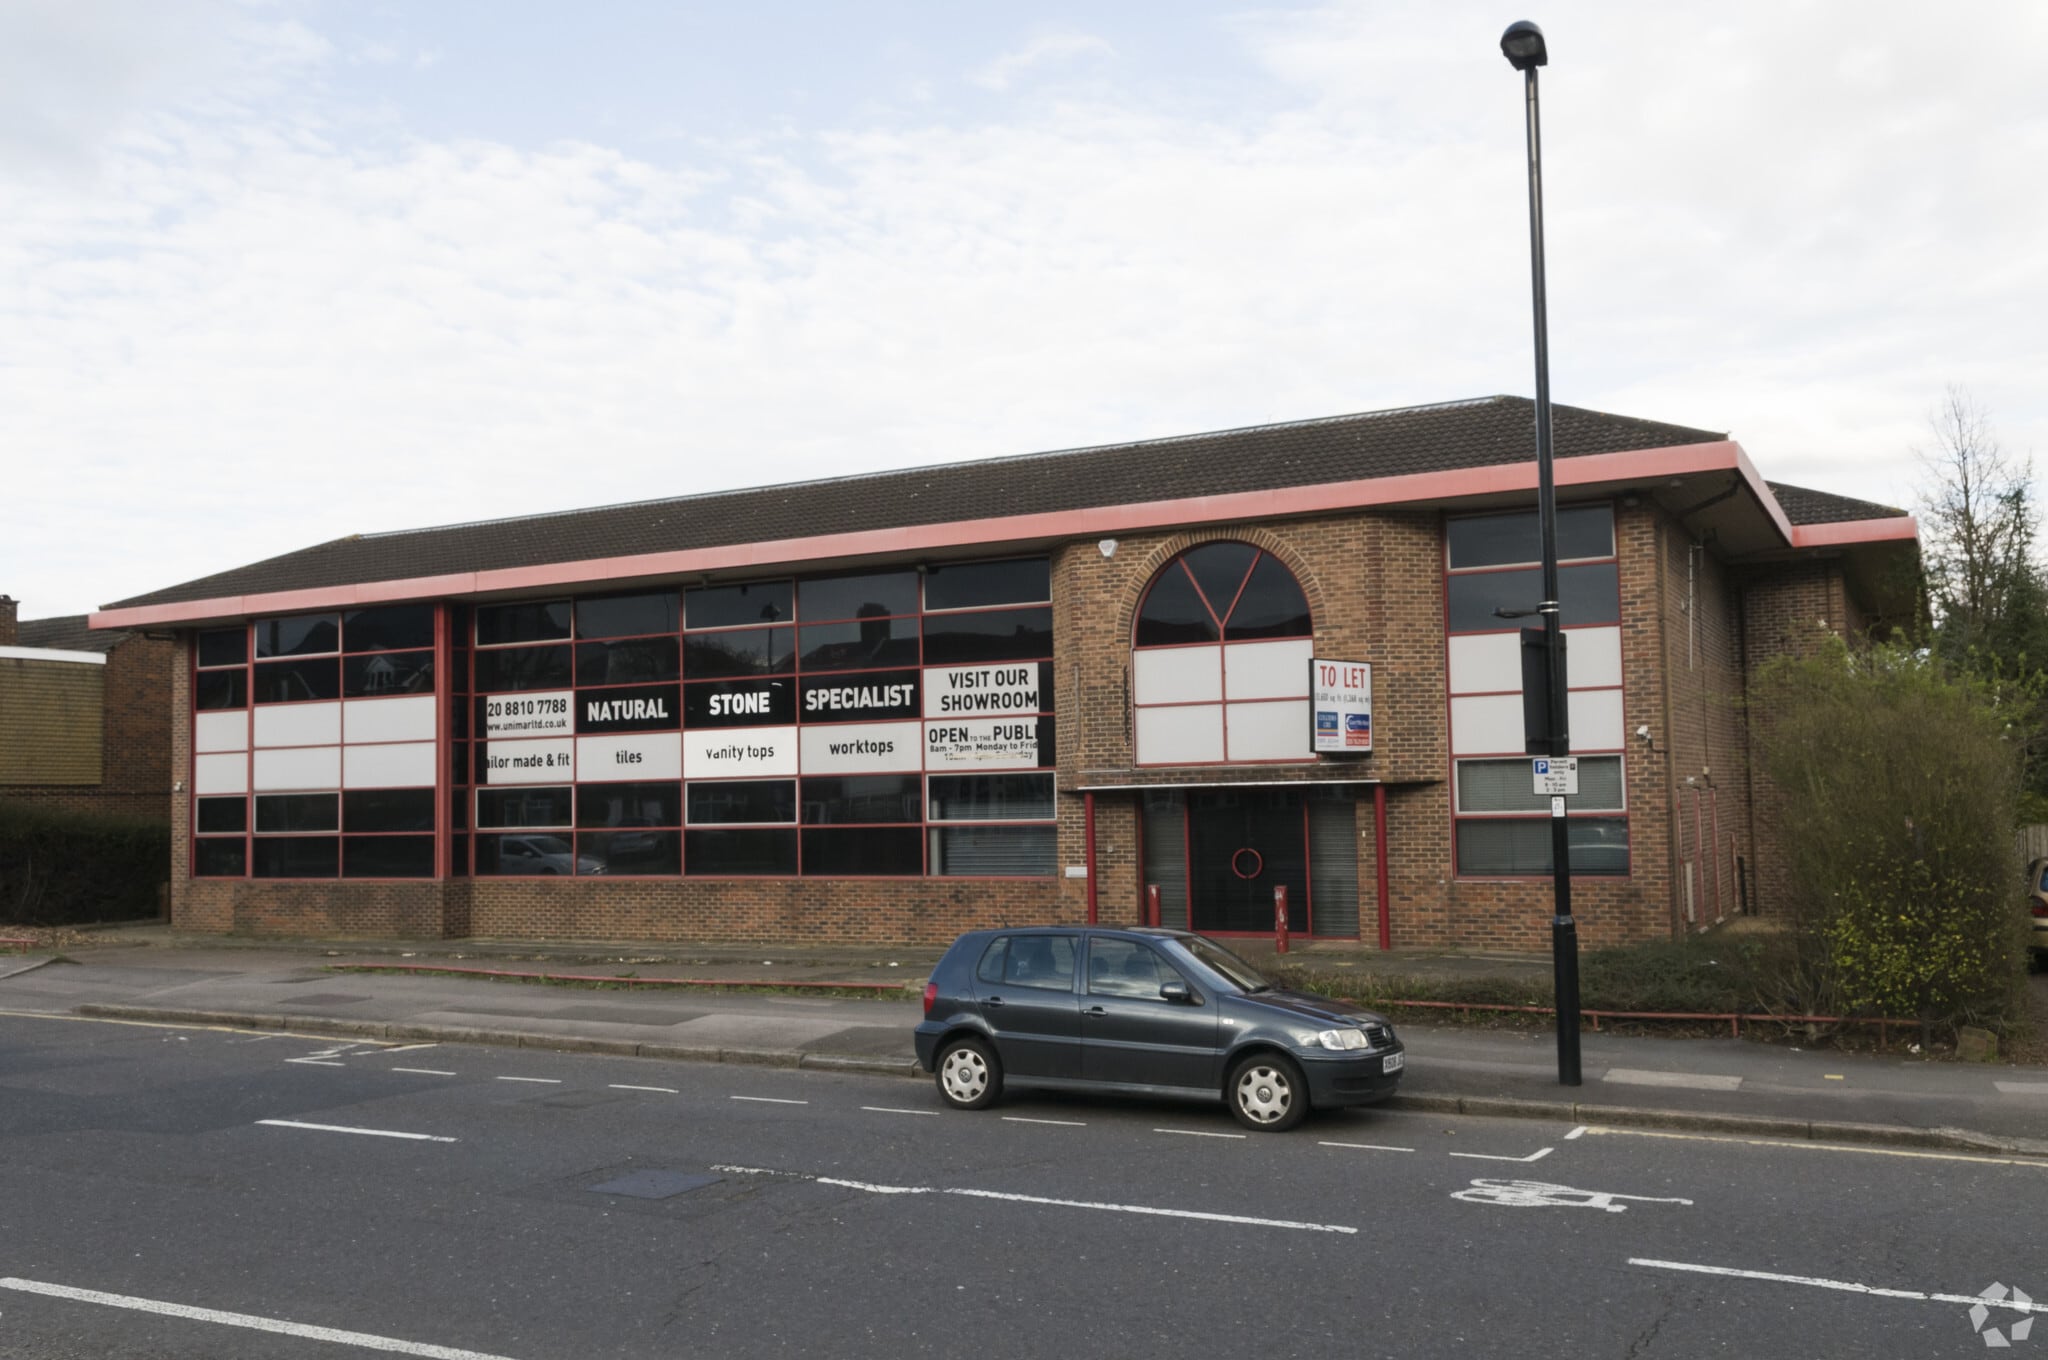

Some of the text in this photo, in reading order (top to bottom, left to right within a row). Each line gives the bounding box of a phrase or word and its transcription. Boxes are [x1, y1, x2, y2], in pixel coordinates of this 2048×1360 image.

[949, 668, 1029, 689] VISIT OUR
[1320, 665, 1366, 689] TO LET
[487, 698, 567, 717] 20 8810 7788
[587, 683, 914, 722] NATURAL STONE SPECIALIST
[940, 690, 1038, 712] SHOWROOM
[929, 727, 968, 743] OPEN
[513, 754, 543, 768] made
[546, 753, 554, 767] &
[557, 753, 570, 767] fit
[616, 750, 642, 764] tiles
[706, 745, 743, 761] vanity
[747, 745, 774, 759] tops
[829, 739, 894, 756] worktops
[954, 744, 972, 752] 7pm
[976, 742, 1008, 751] Monday
[1010, 741, 1018, 749] to
[1537, 761, 1547, 773] P
